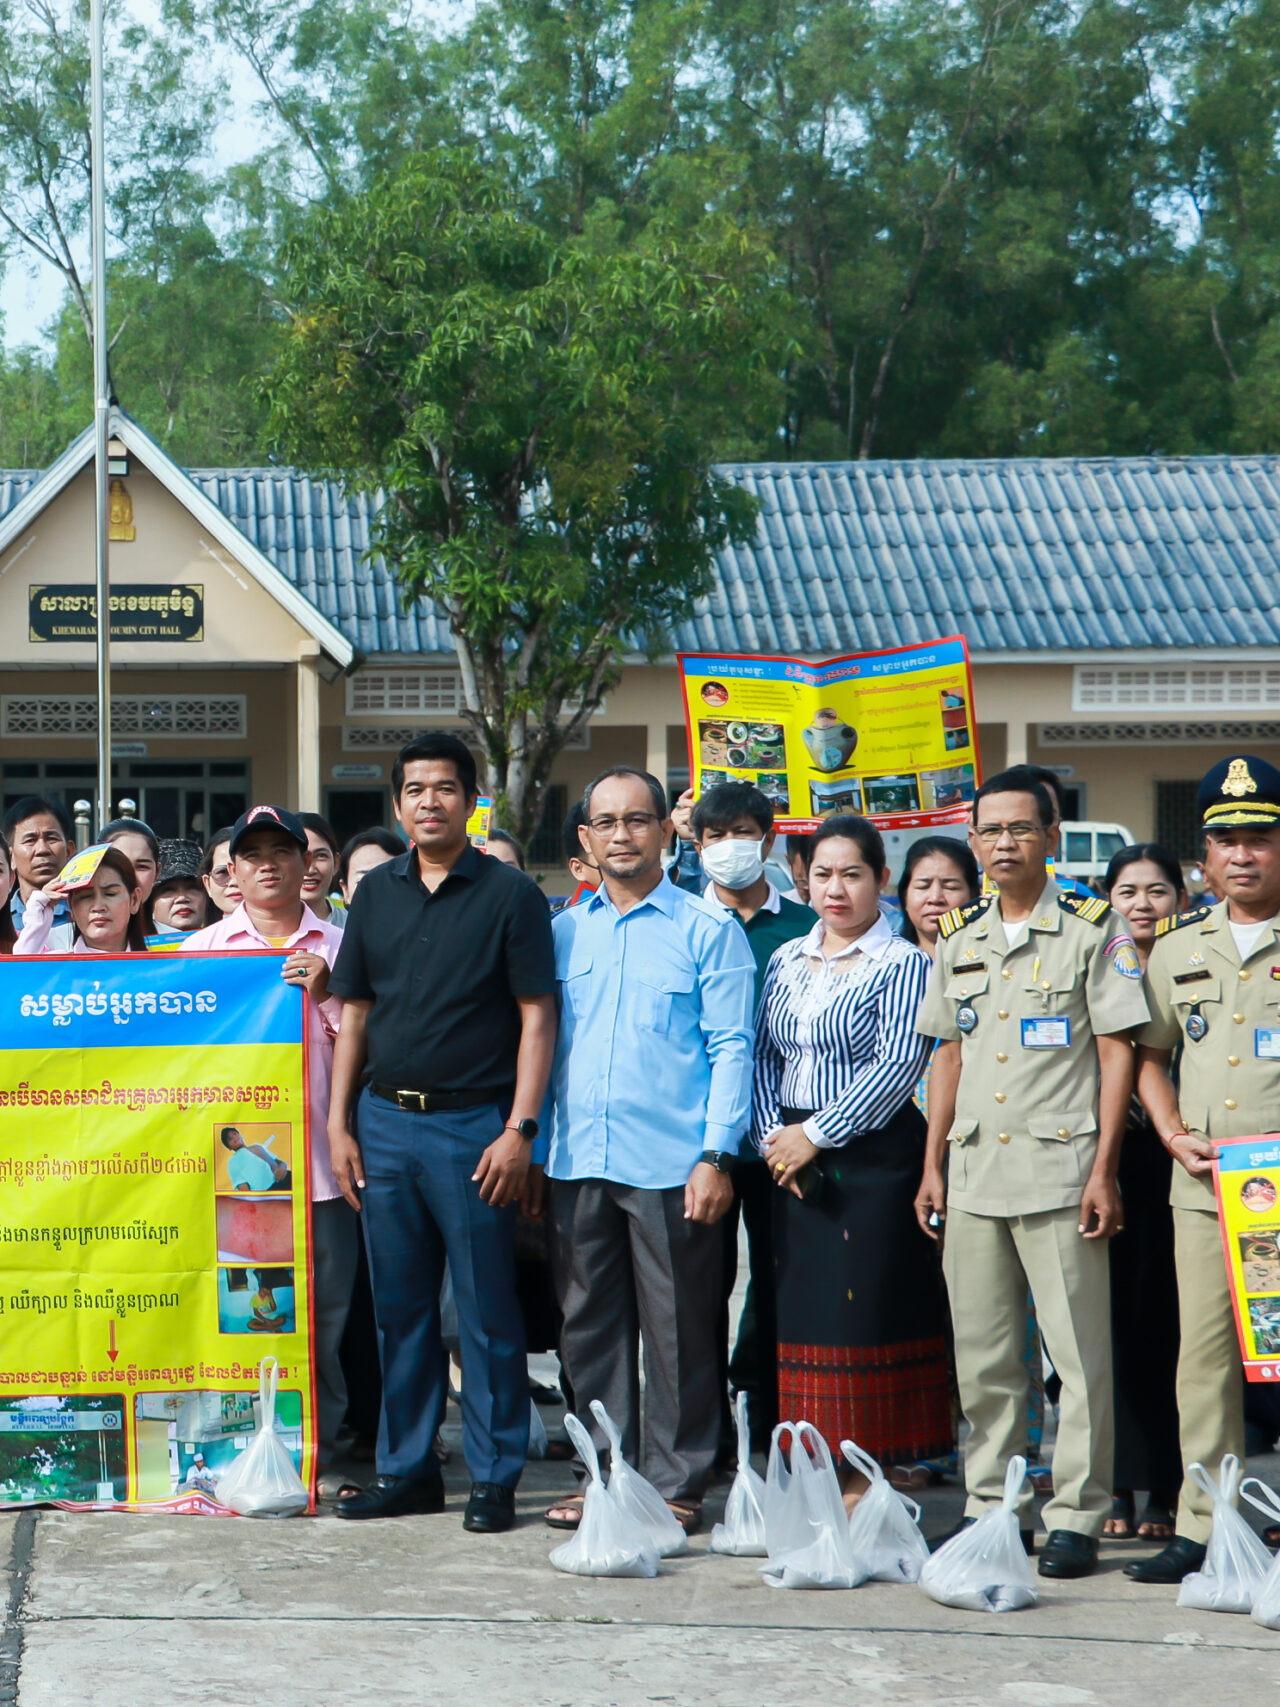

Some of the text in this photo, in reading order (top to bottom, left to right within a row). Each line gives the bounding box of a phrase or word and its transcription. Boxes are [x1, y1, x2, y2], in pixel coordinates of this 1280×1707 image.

[139, 625, 158, 635] CITY
[160, 625, 181, 635] HALL
[20, 981, 217, 1027] សម្លាប់អ្នកបាន
